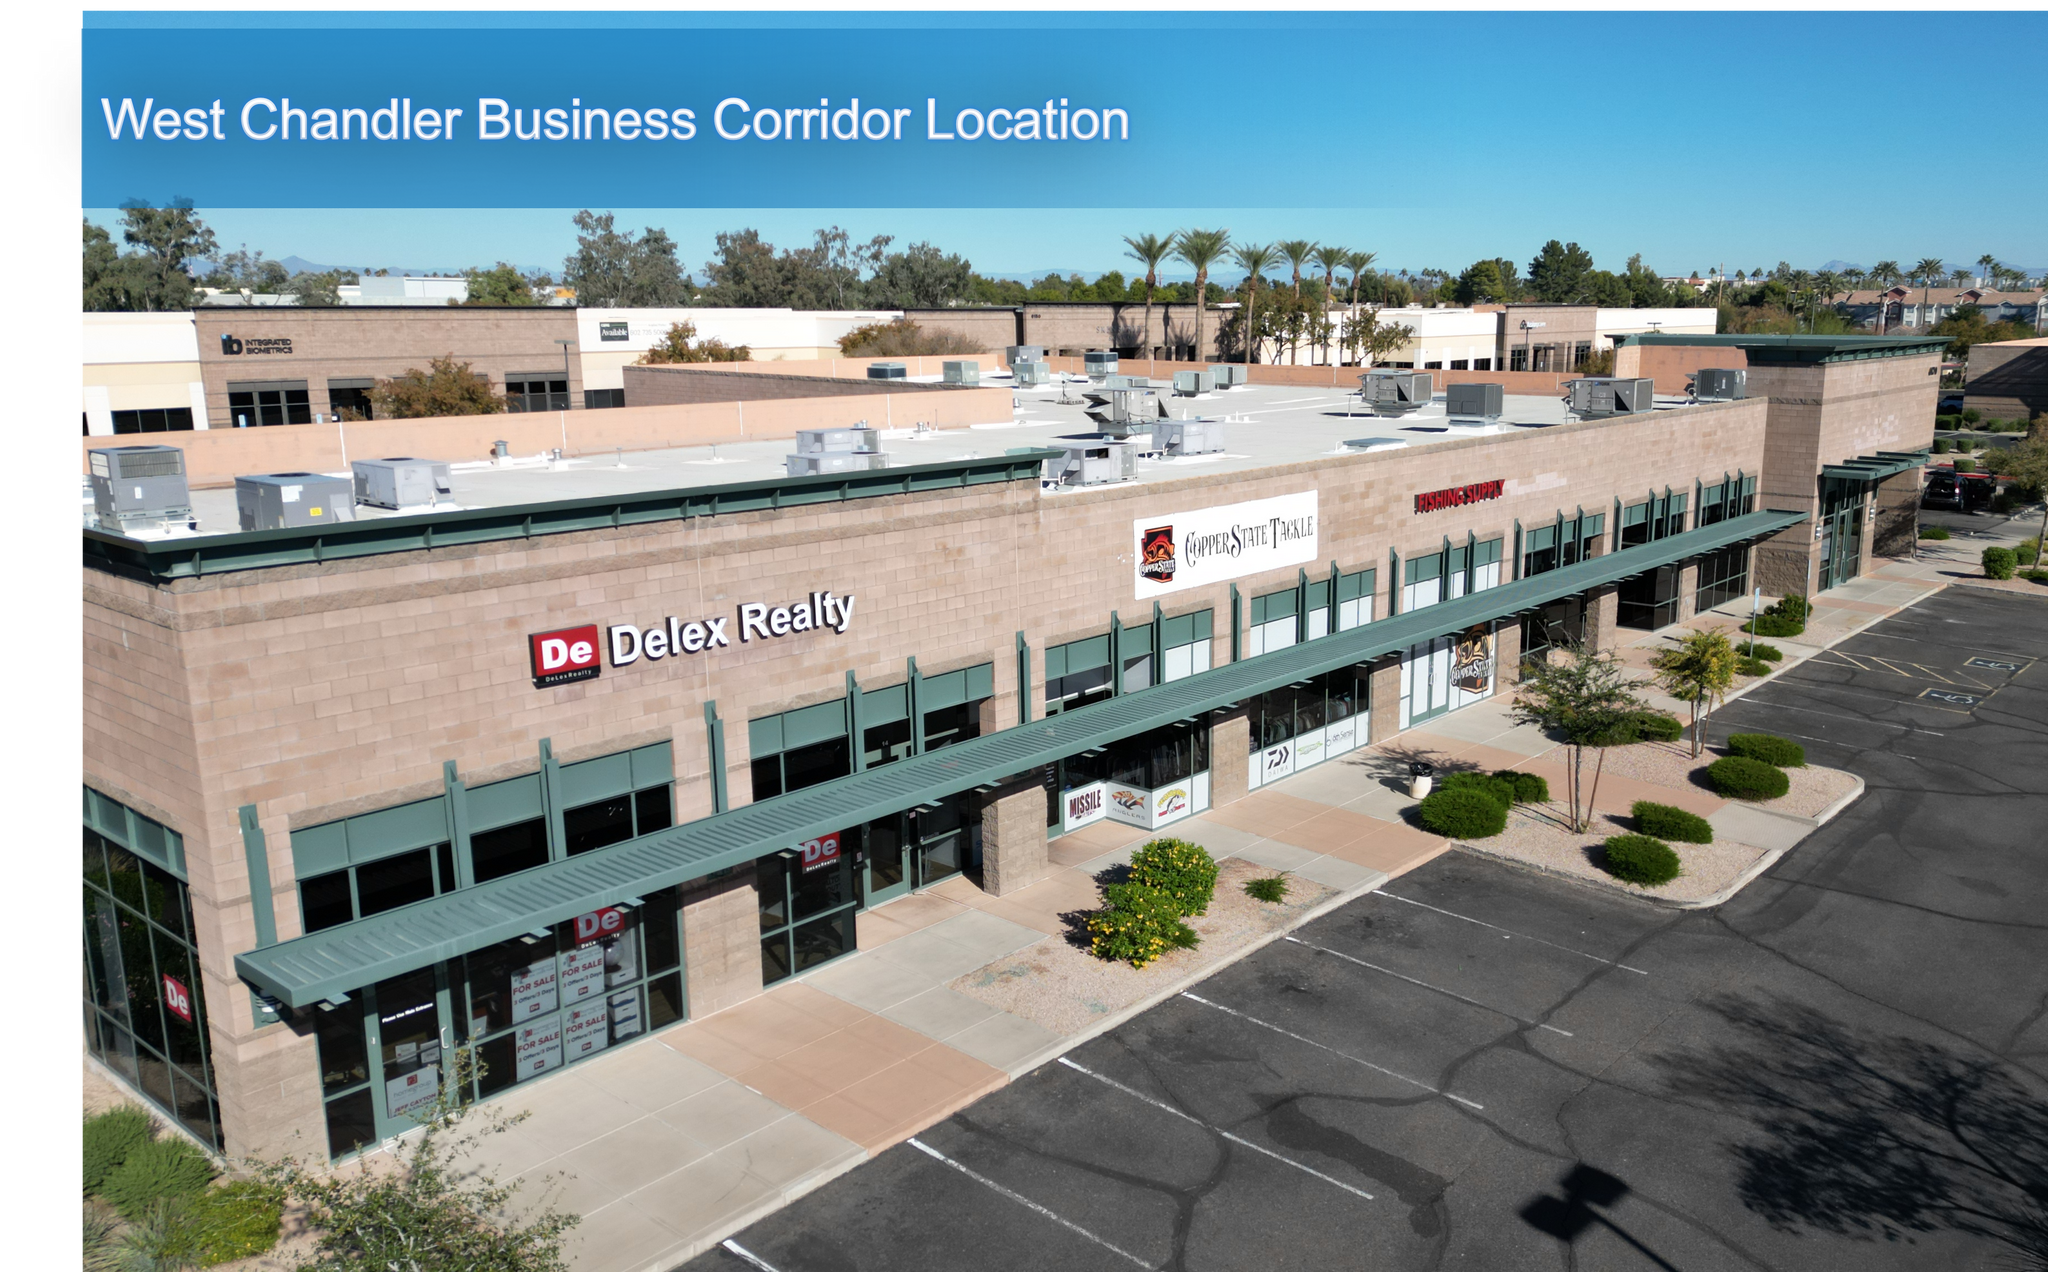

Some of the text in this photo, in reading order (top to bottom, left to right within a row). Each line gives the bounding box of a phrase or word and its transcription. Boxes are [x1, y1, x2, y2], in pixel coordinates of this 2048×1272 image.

[601, 328, 628, 337] Available
[246, 346, 293, 355] BIOMETRICS
[1415, 479, 1505, 513] FISHING SUPPLY
[1269, 516, 1314, 549] TACKLE
[607, 591, 854, 668] Delex Realty
[541, 638, 593, 670] De
[1268, 765, 1289, 778] DAIWA
[1069, 789, 1101, 818] MISSILE
[804, 839, 837, 863] De
[578, 911, 620, 939] De
[562, 966, 580, 979] FOR
[581, 958, 603, 972] SALE
[165, 978, 188, 1015] De
[512, 983, 531, 996] FOR
[533, 974, 555, 988] SALE
[565, 1022, 583, 1035] FOR
[585, 1013, 606, 1027] SALE
[517, 1031, 560, 1053] FOR SALE
